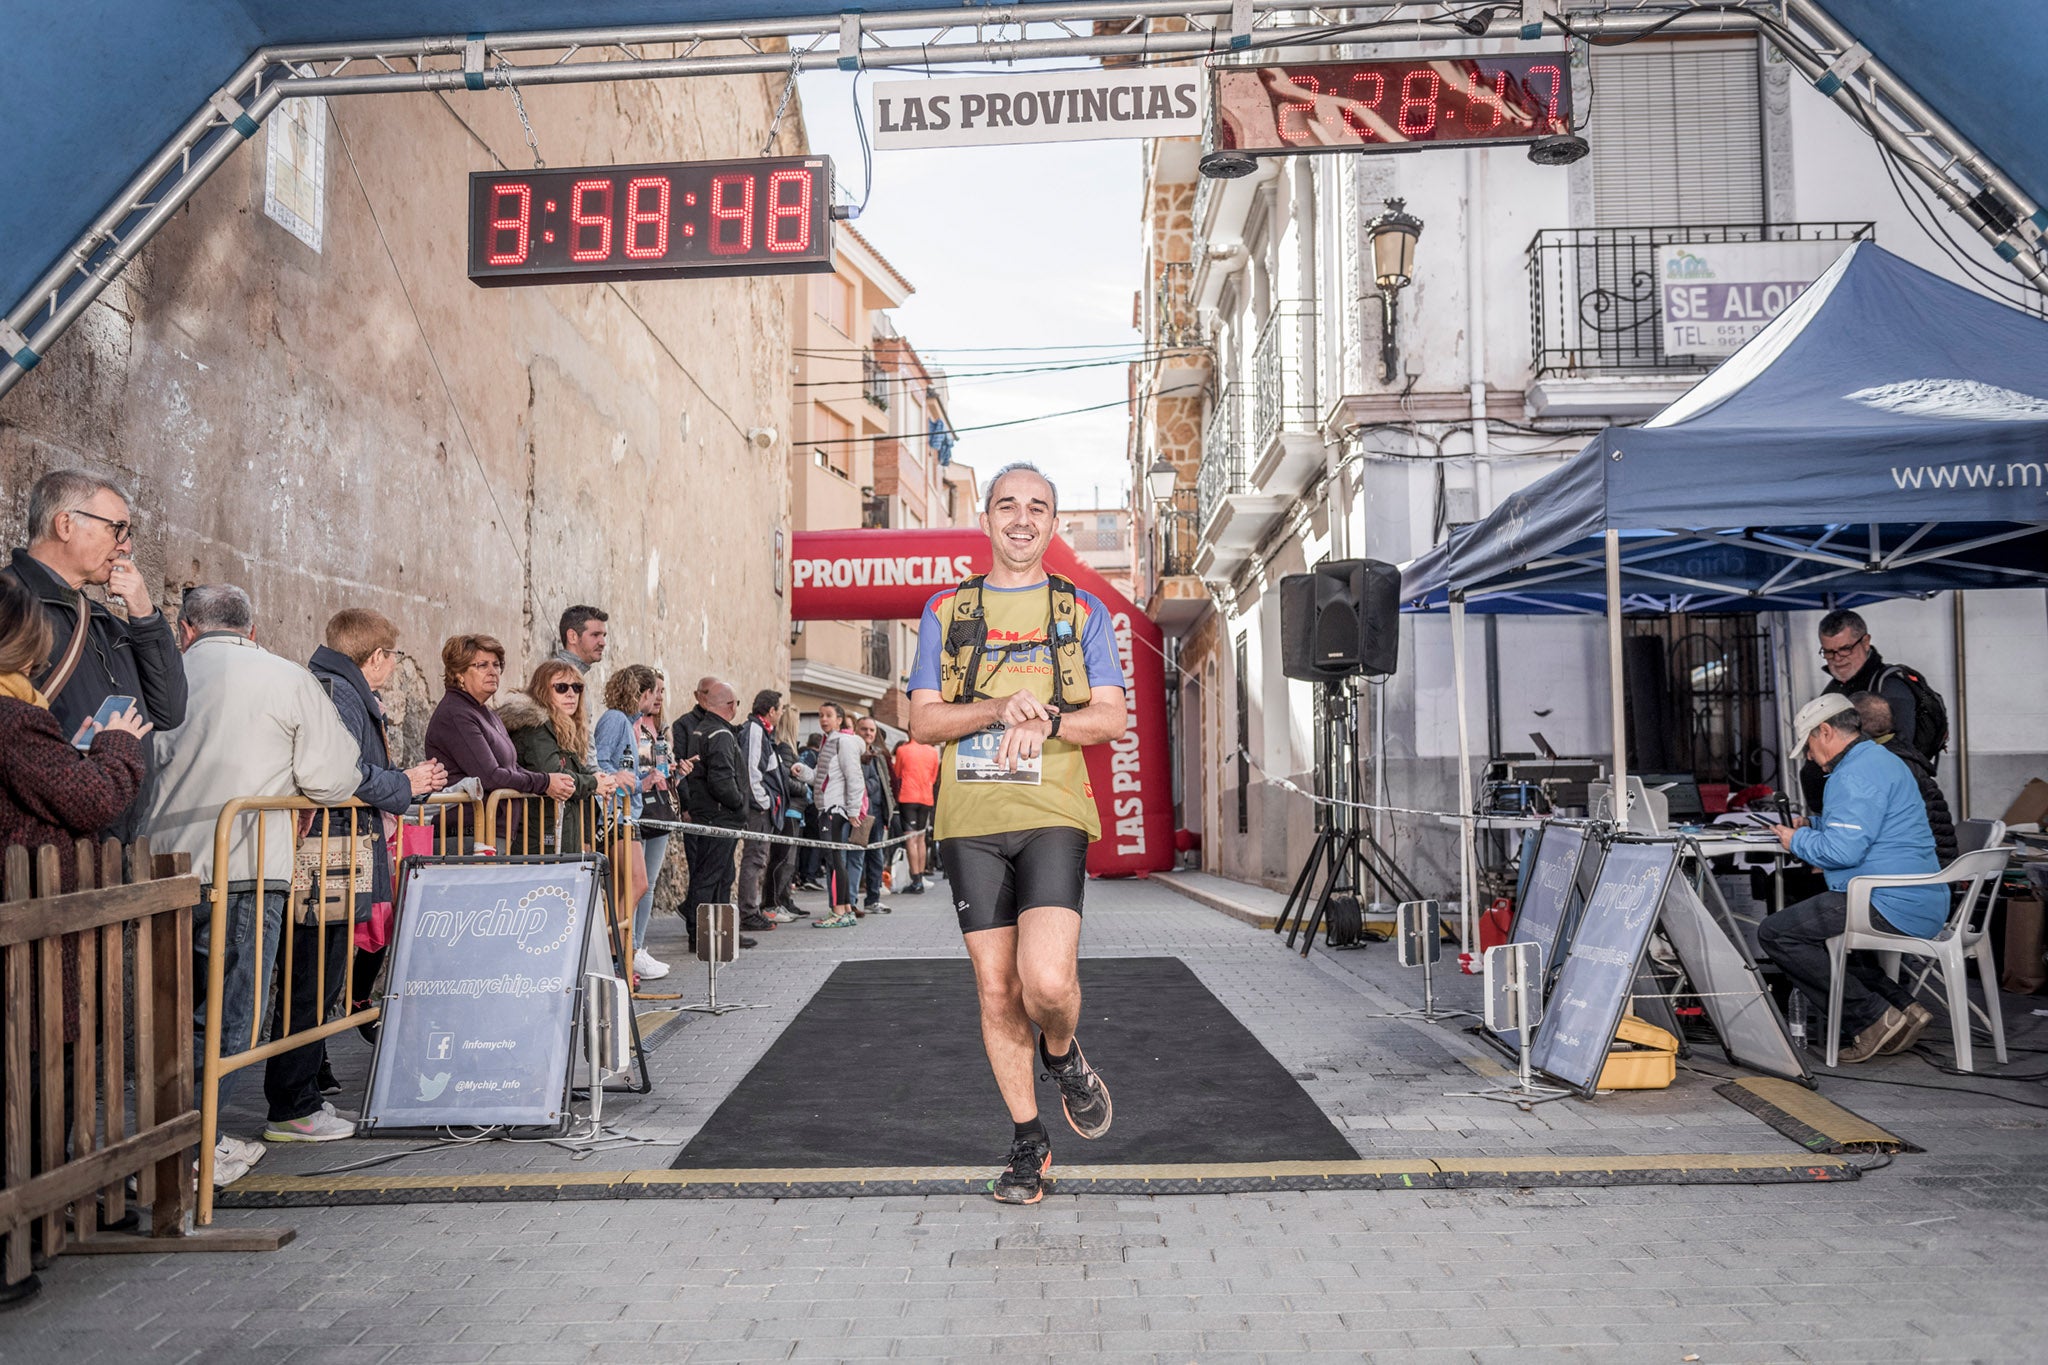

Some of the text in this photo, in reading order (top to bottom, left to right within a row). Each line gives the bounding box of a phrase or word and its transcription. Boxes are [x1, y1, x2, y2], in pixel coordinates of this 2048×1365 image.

[878, 83, 1197, 133] LAS PROVINCIAS
[1279, 66, 1561, 140] 2:28:47
[488, 169, 812, 266] 3:58:48
[1670, 286, 1710, 319] SE
[1717, 325, 1744, 335] 651
[1890, 462, 2048, 497] www.m
[792, 555, 973, 588] PROVINCIAS
[1006, 665, 1054, 675] VALENCI
[1114, 797, 1146, 856] LAS
[415, 898, 548, 947] mychip
[404, 973, 562, 998] www.mychip.es
